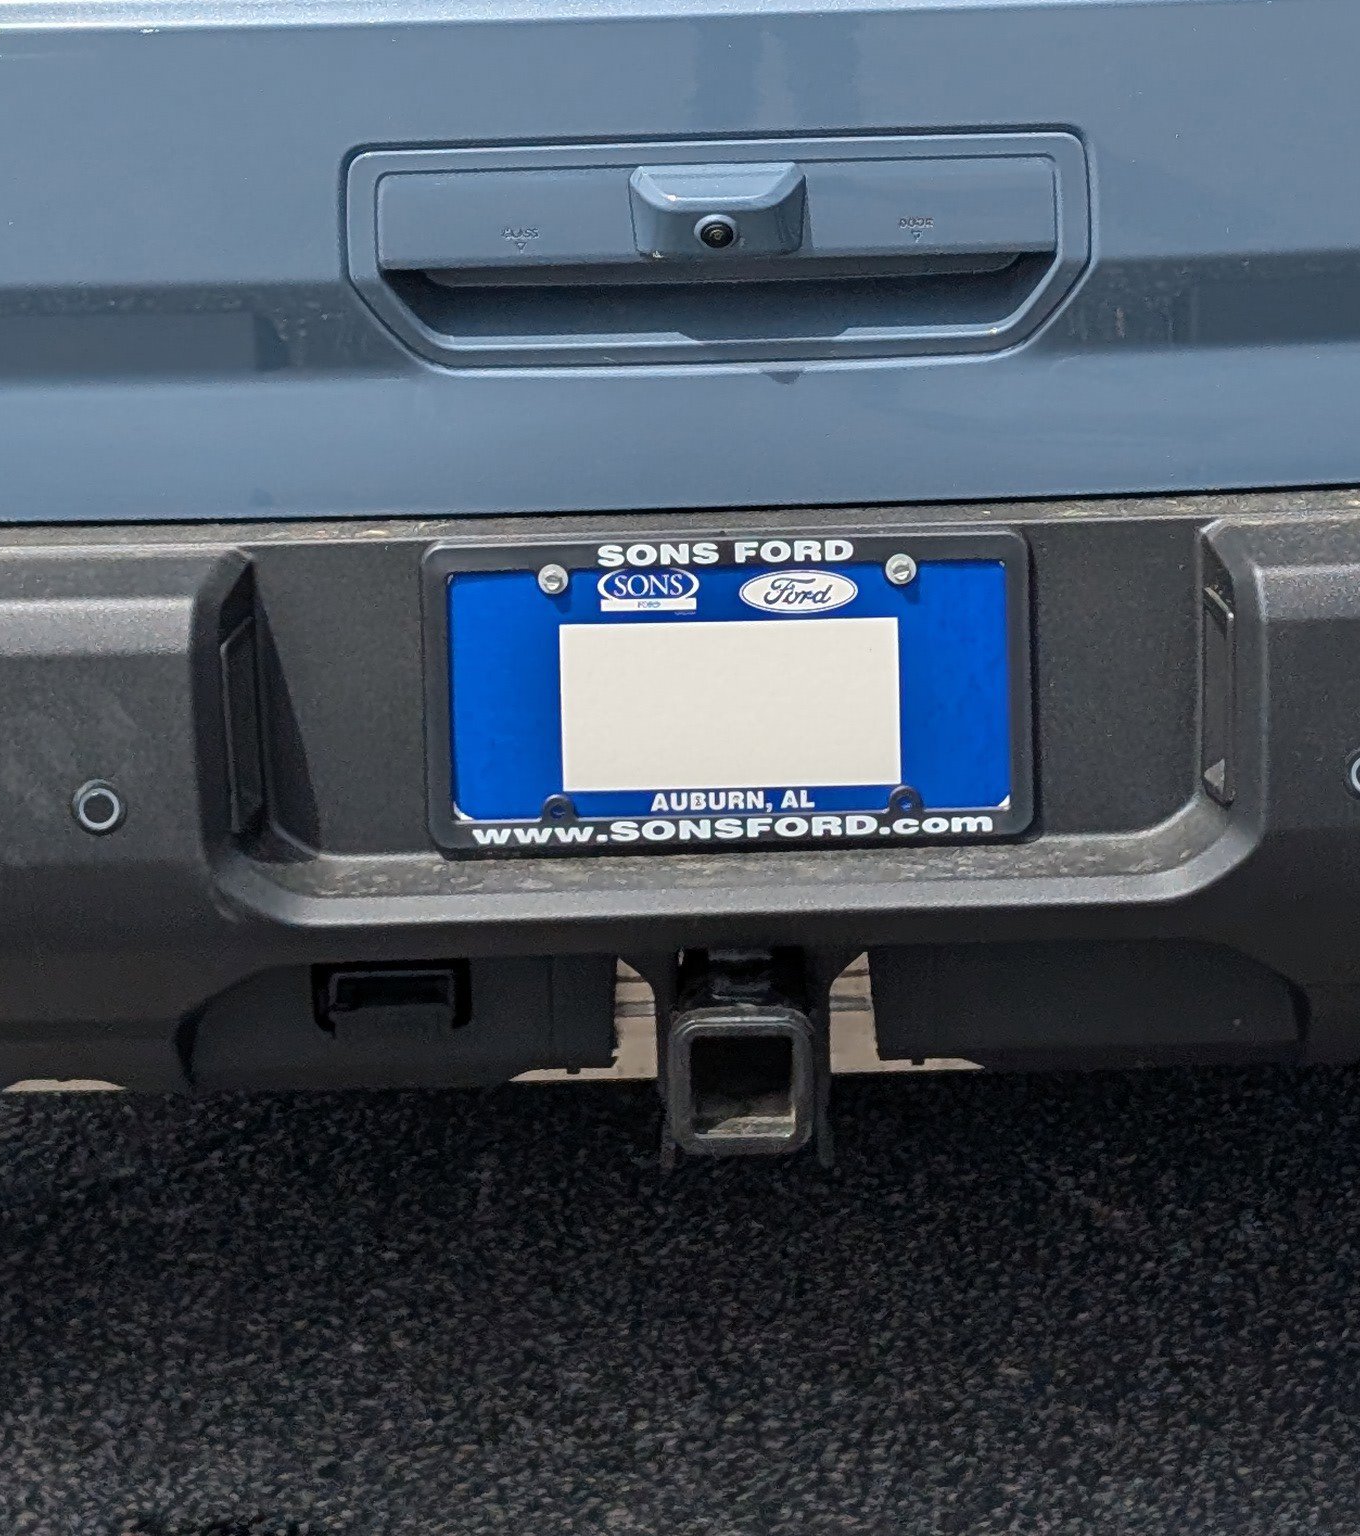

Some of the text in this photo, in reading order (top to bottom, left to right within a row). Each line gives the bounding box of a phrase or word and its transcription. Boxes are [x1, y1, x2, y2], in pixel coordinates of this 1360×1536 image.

[597, 540, 854, 567] SONS FORD
[613, 573, 684, 596] SONS
[763, 577, 833, 605] Ford
[650, 790, 815, 814] AUBURN, AL
[471, 814, 995, 846] www.SONSFORD.com
